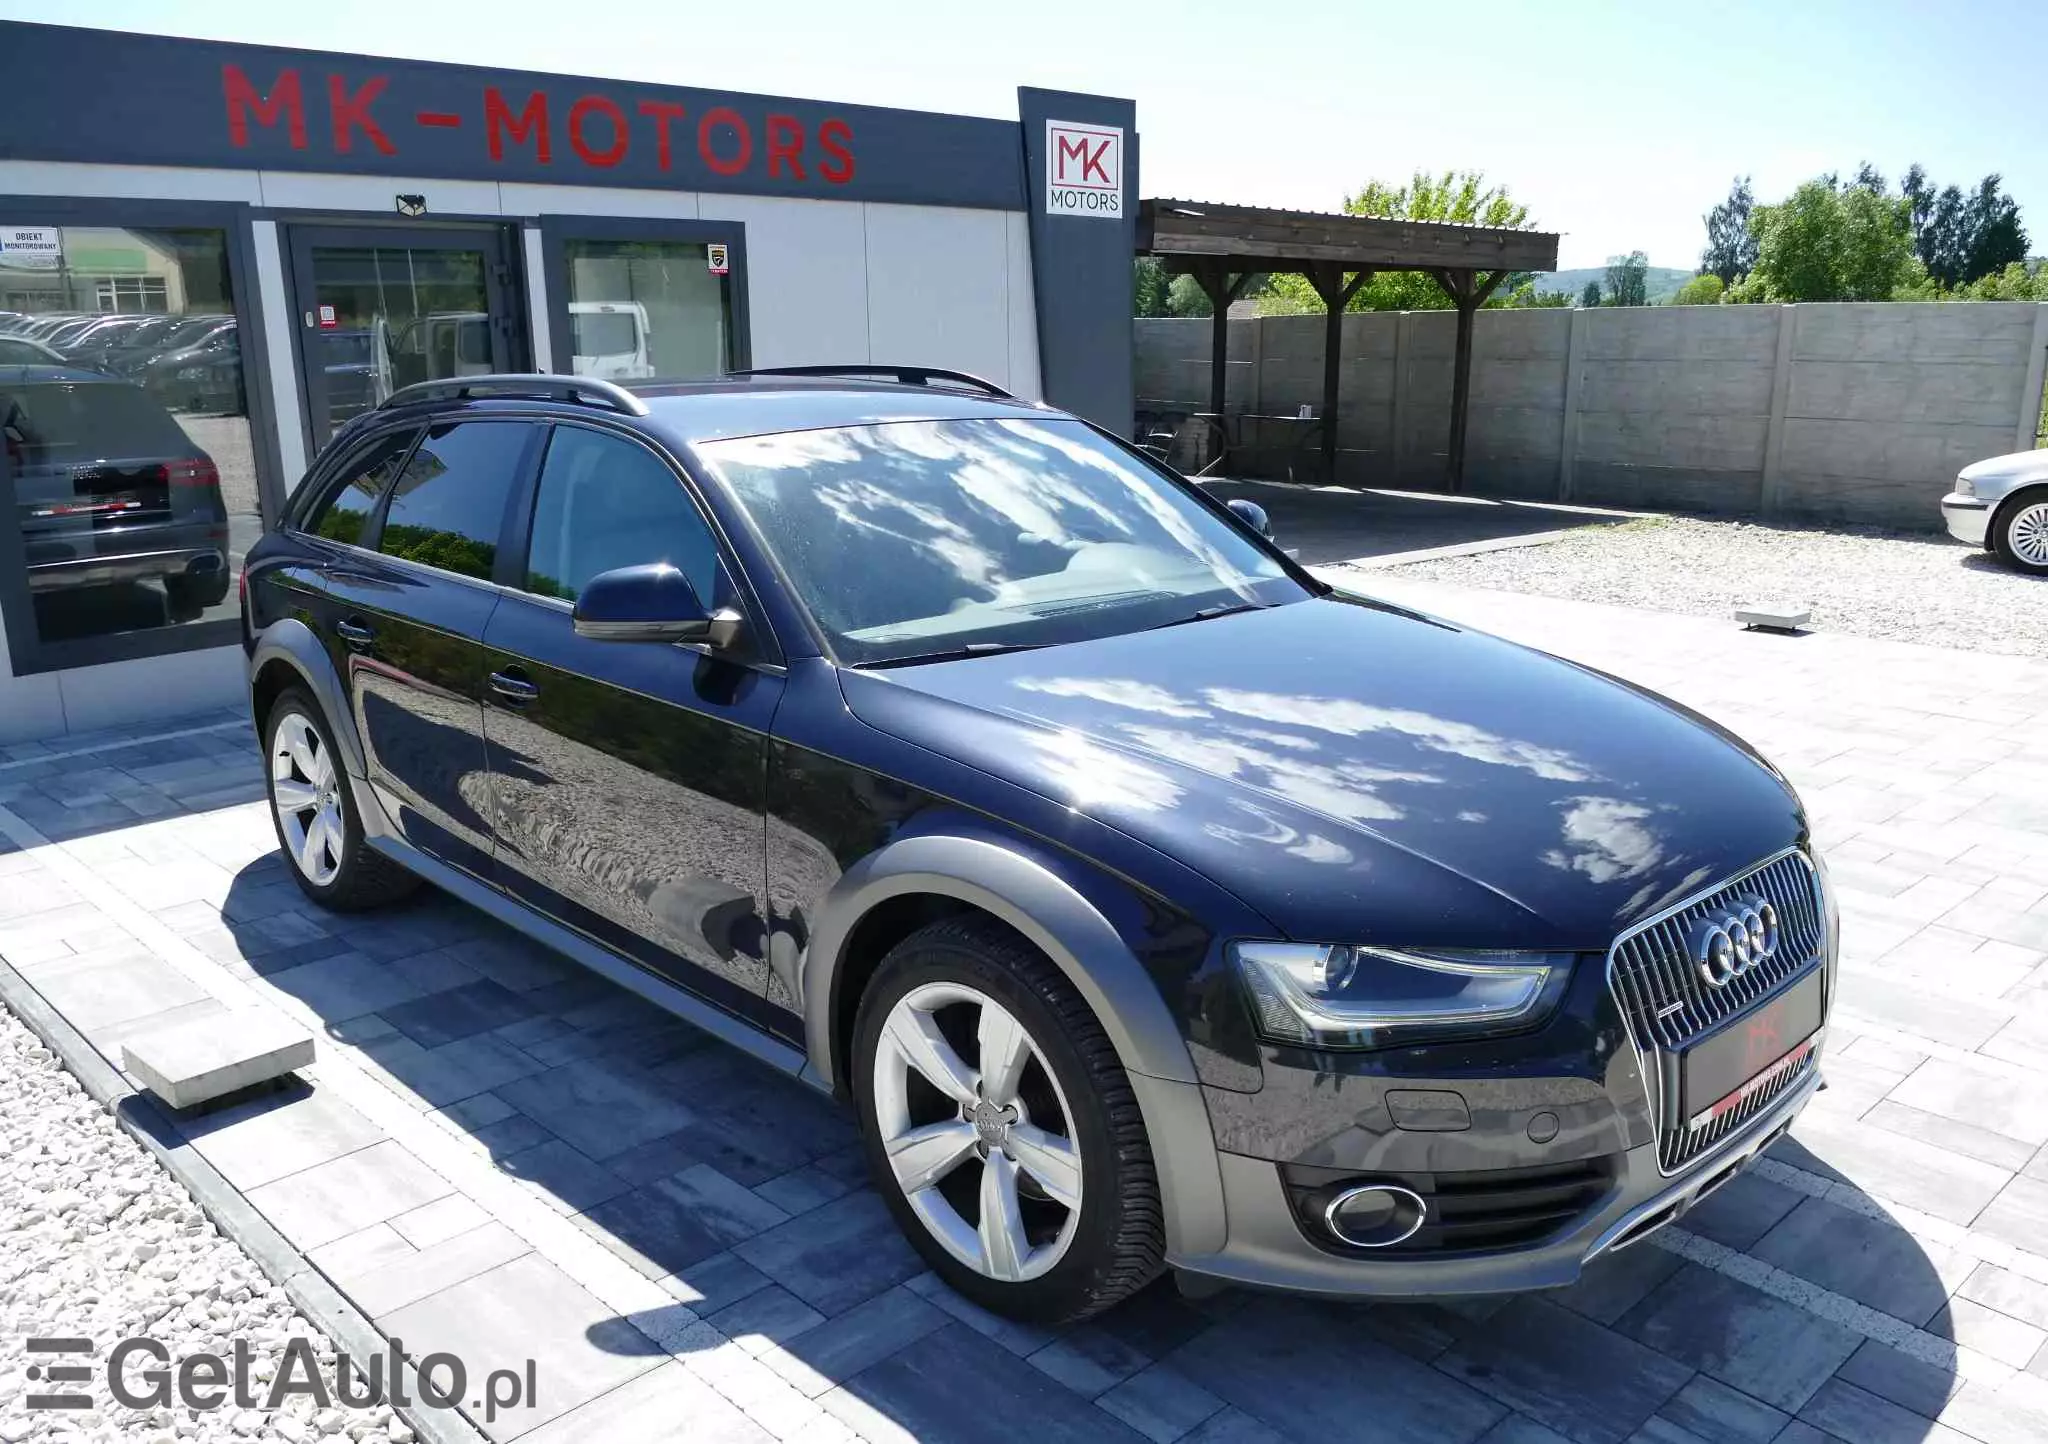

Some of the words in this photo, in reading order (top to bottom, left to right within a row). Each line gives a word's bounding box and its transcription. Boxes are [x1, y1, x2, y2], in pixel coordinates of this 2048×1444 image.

[1058, 135, 1112, 184] MK
[1051, 189, 1119, 211] MOTORS
[15, 232, 42, 241] OBIEKT
